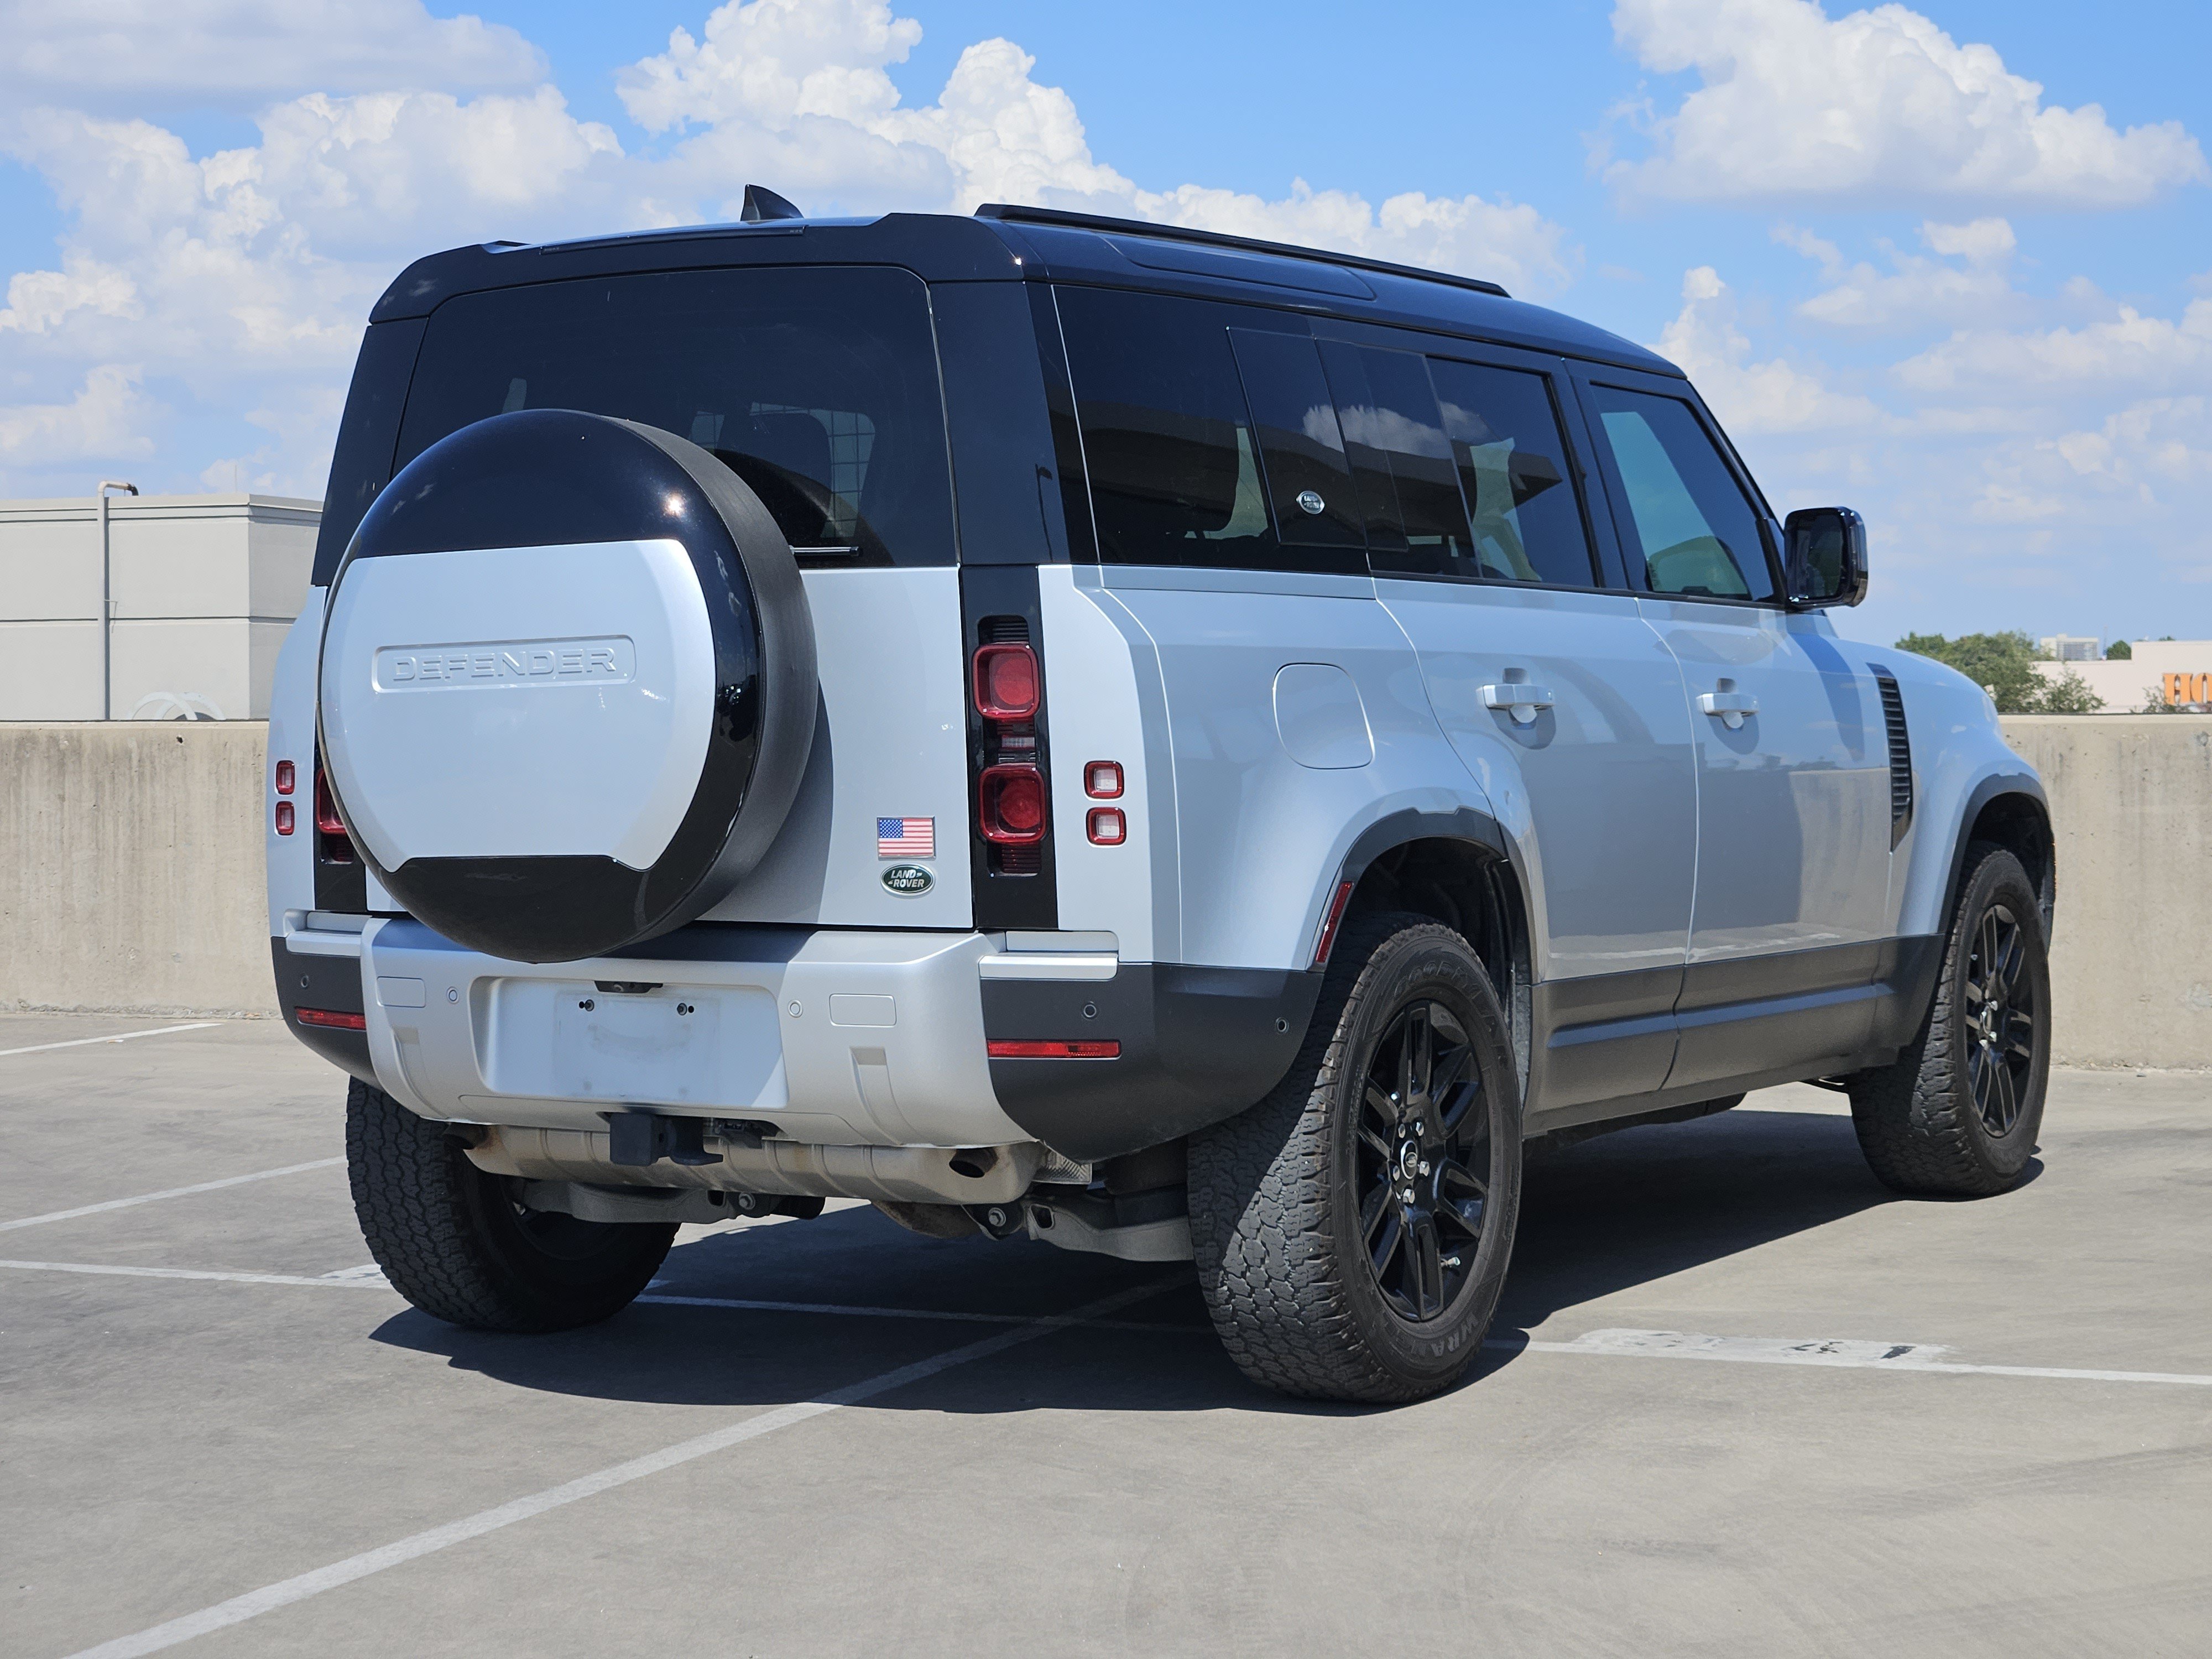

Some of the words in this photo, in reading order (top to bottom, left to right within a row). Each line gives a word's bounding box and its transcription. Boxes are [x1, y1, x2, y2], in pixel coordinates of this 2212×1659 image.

[393, 647, 616, 681] DEFENDER
[891, 869, 916, 879] LAND
[893, 879, 924, 888] ROVER
